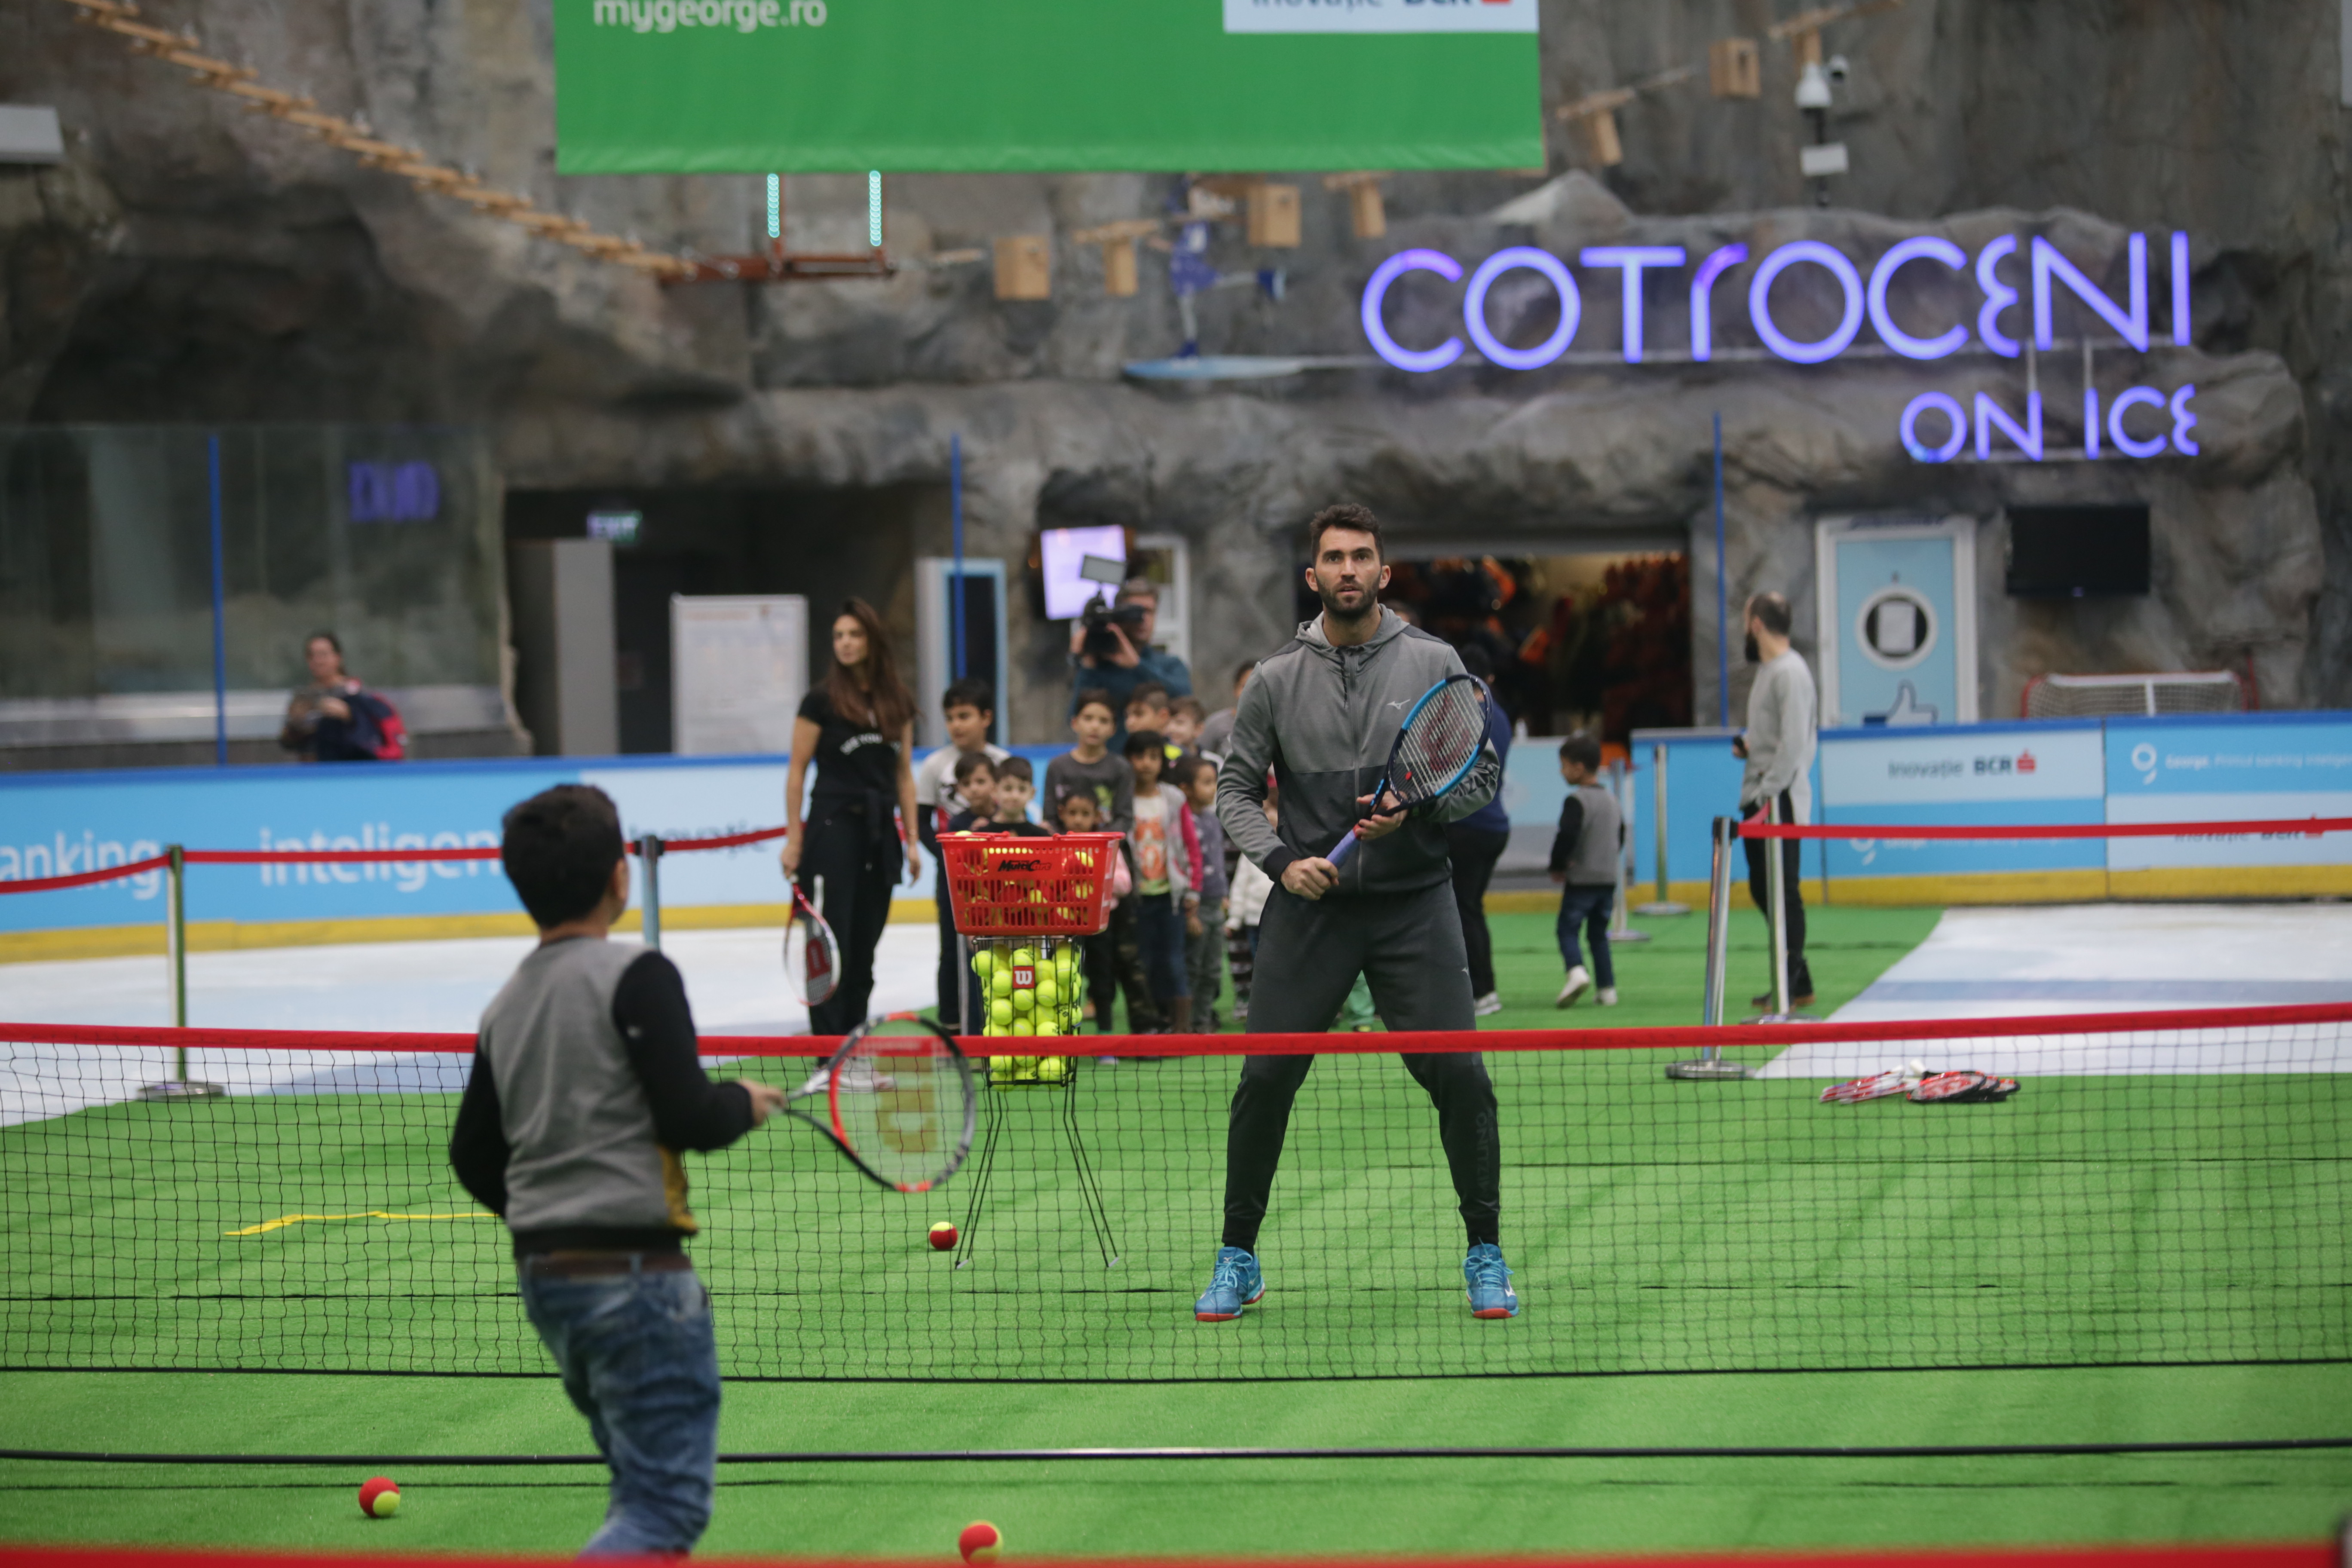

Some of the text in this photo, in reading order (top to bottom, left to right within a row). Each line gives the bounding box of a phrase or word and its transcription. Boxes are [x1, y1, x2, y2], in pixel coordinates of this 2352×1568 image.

[594, 0, 827, 33] mygeorge.ro
[1899, 384, 2199, 462] ON ICE
[1974, 755, 2012, 775] BCR
